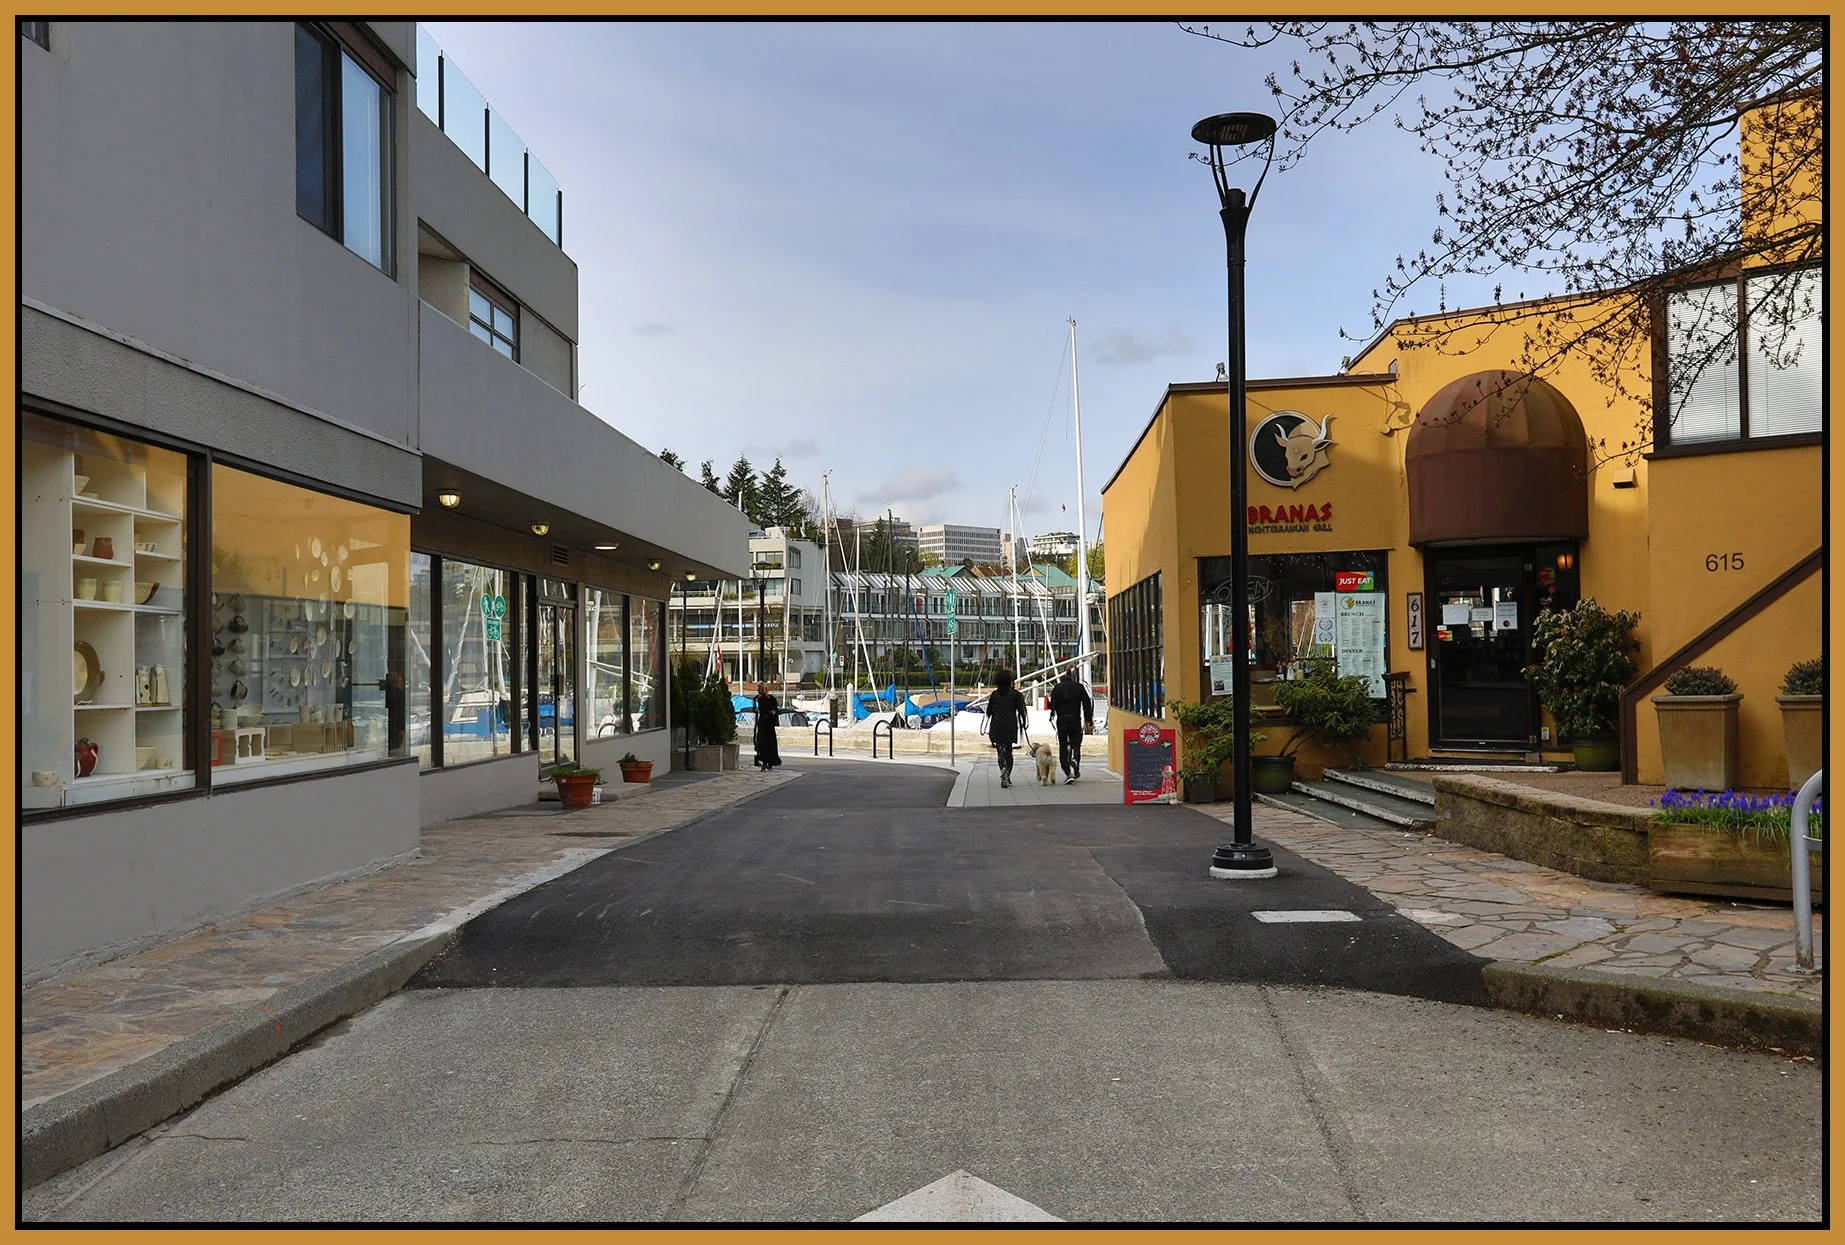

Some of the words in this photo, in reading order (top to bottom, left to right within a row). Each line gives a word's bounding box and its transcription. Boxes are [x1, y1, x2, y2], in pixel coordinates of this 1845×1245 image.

[1247, 502, 1332, 524] BRANAS
[1313, 524, 1333, 532] GRILL
[1705, 552, 1745, 572] 615
[1217, 578, 1270, 601] OEN
[1339, 577, 1357, 586] JUST
[1411, 599, 1419, 644] 617
